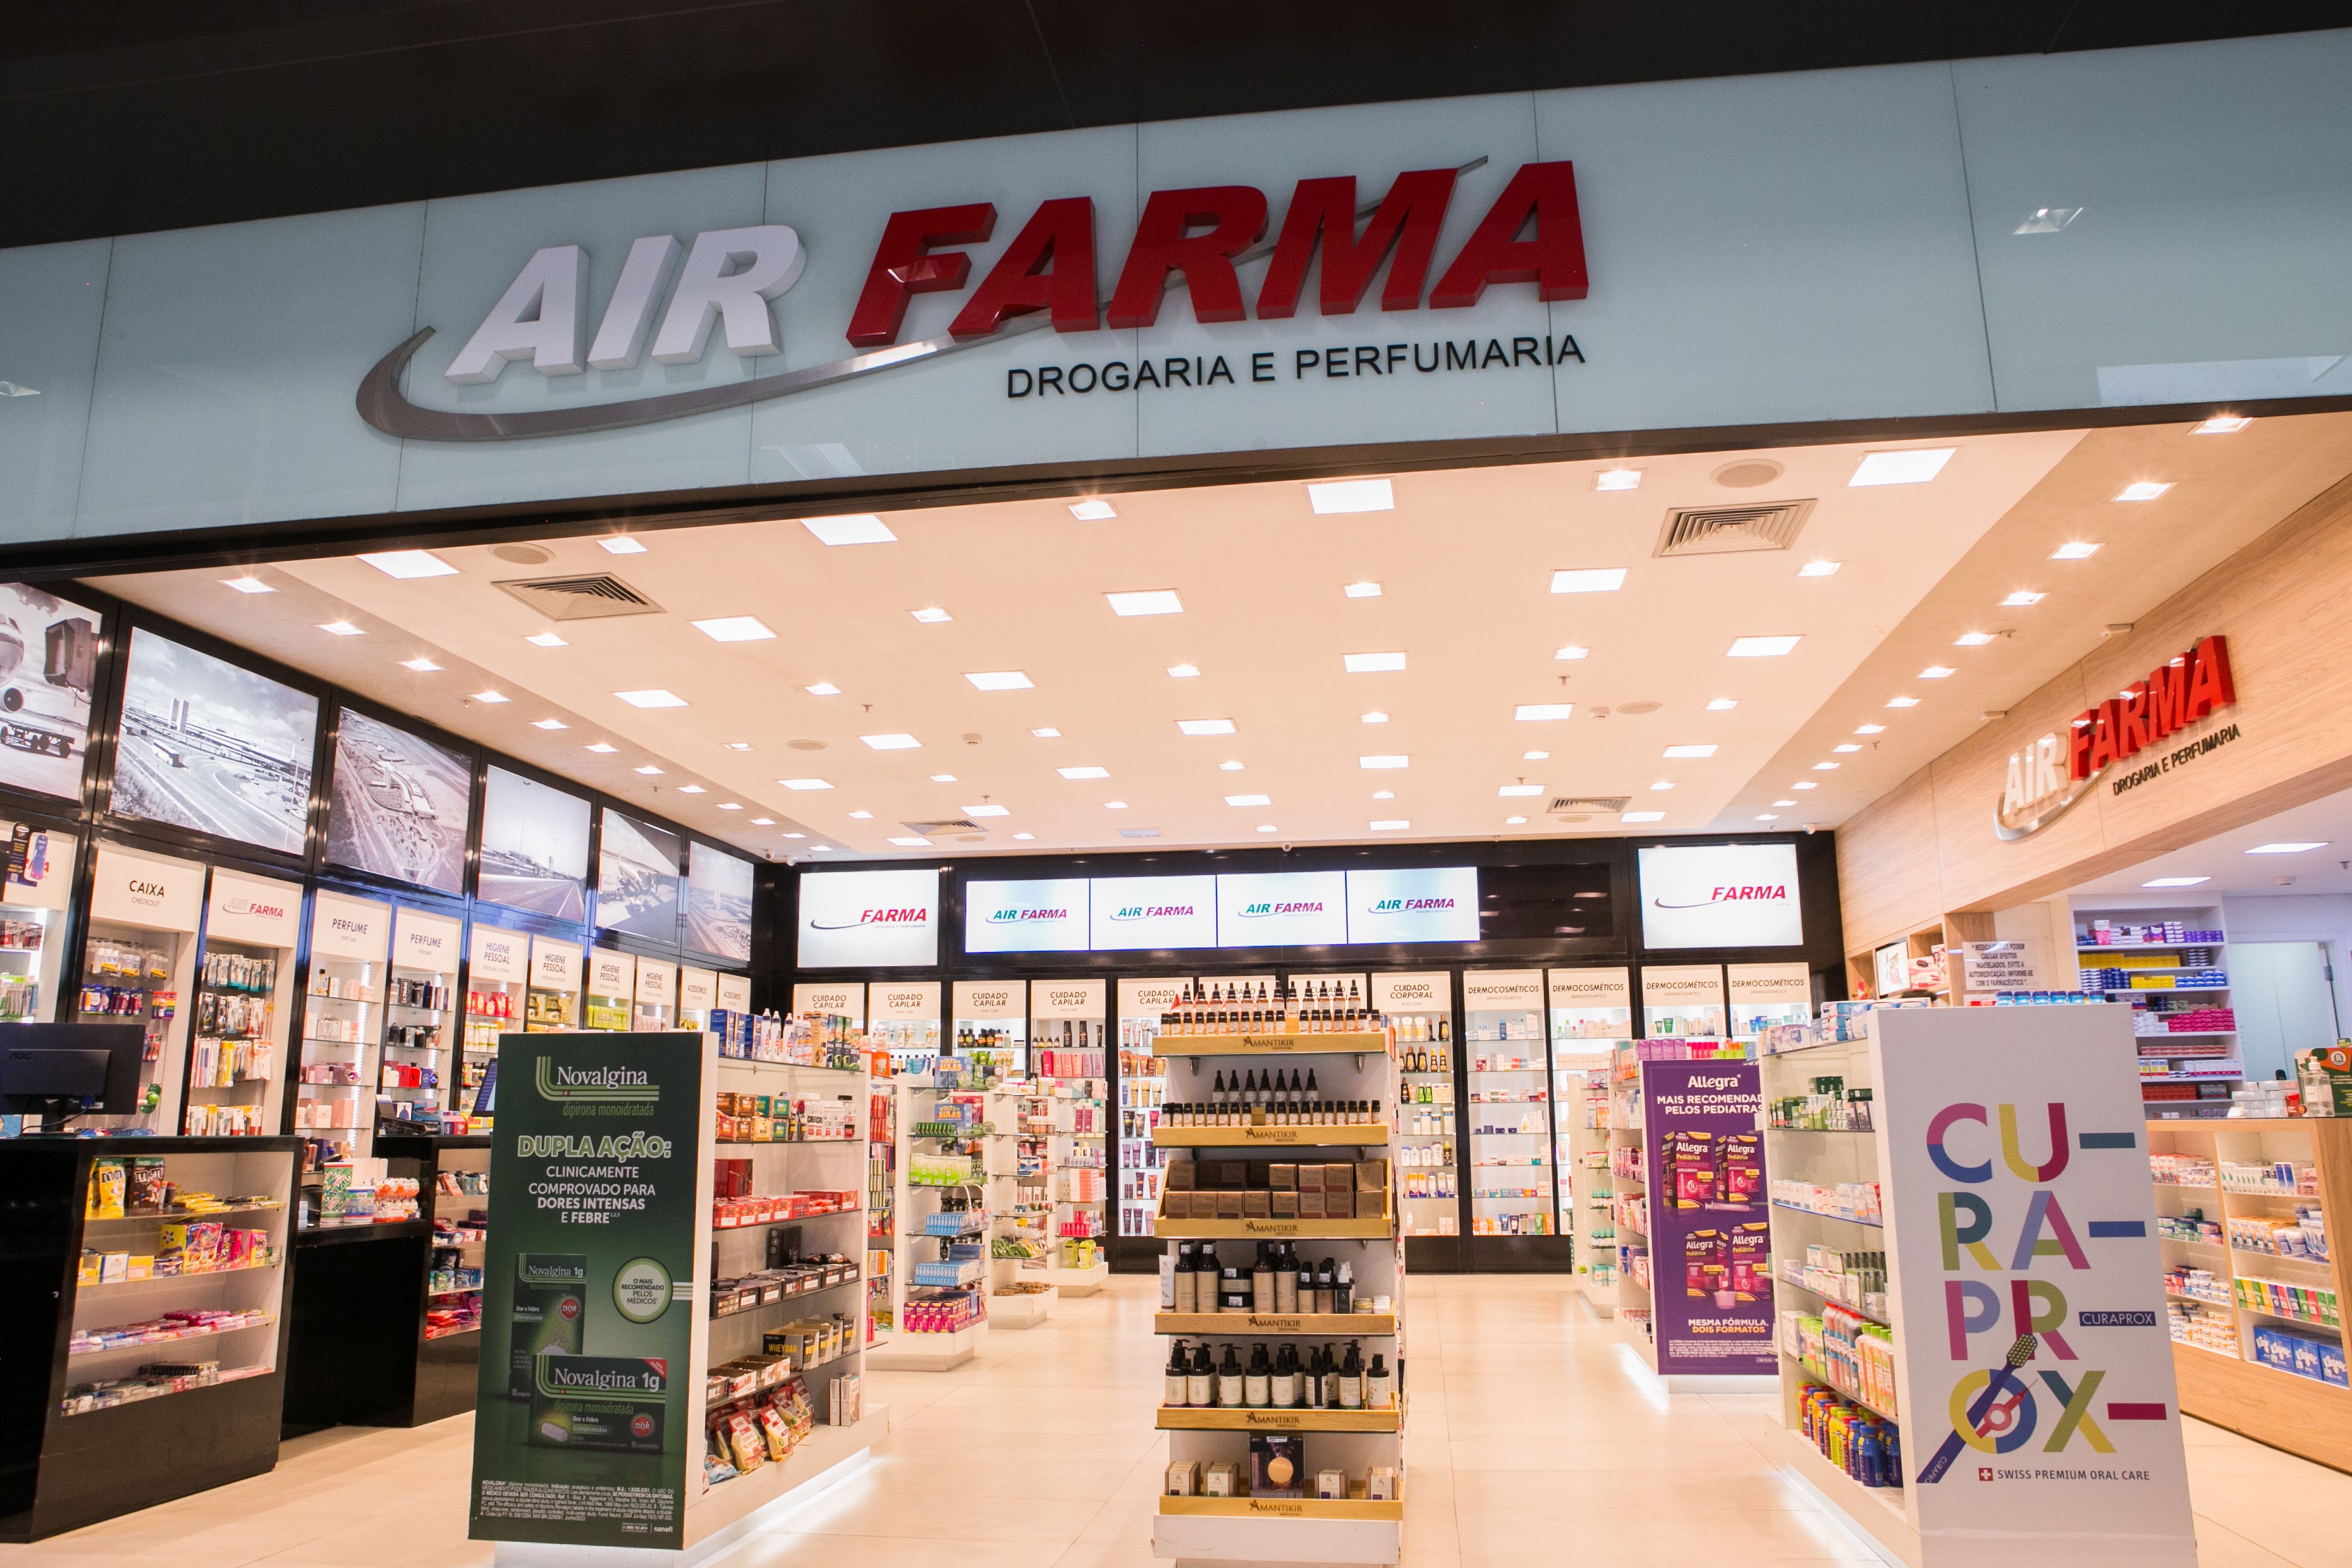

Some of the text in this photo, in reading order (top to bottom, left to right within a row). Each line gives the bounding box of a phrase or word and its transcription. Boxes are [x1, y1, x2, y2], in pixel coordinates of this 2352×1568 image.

[445, 160, 1589, 384] AIR FARMA
[1007, 334, 1586, 399] DROGARIA E PERFUMARIA
[2002, 635, 2236, 816] AIR FARMA
[2112, 723, 2241, 796] DROGARIA E PERFUMARIA
[129, 880, 165, 897] CAIXA
[1712, 885, 1786, 900] FARMA
[131, 897, 160, 907] CHECKOUT
[229, 897, 248, 911] AIR
[249, 903, 283, 918] FARMA
[1245, 902, 1323, 913] AIR FARMA
[1375, 899, 1455, 910] AIR FARMA
[860, 908, 926, 923] FARMA
[993, 909, 1067, 919] AIR FARMA
[1118, 906, 1194, 916] AIR FARMA
[332, 918, 368, 934] PERFUME
[410, 934, 442, 948] PERFUME
[486, 942, 510, 954] HIGIENE
[484, 952, 509, 964] PESSOAL
[544, 953, 566, 964] HIGIENE
[543, 962, 566, 974] PESSOAL
[601, 963, 620, 974] HIGIENE
[599, 972, 620, 983] PESSOAL
[646, 971, 663, 981] HIGIENE
[1732, 977, 1804, 987] DERMOCOSMÉTICOS
[645, 980, 663, 990] PESSOAL
[1468, 984, 1539, 994] DERMOCOSMÉTICOS
[1553, 982, 1624, 992] DERMOCOSMÉTICOS
[1647, 979, 1718, 990] DERMOCOSMÉTICOS
[556, 1066, 648, 1089] Novalgina
[1657, 1094, 1762, 1104] MAIS RECOMENDAD
[563, 1101, 654, 1119] dipirona monoidratada
[938, 1111, 962, 1119] AULAS
[1665, 1104, 1763, 1114] PELOS PEDIATRAS
[518, 1131, 672, 1163] DUPLA AÇÃO:
[1676, 1142, 1708, 1154] Allegra
[1727, 1144, 1755, 1155] Allegra
[546, 1166, 640, 1178] CLINICAMENTE
[528, 1182, 656, 1195] COMPROVADO PARA
[538, 1197, 645, 1210] DORES INTENSAS
[561, 1212, 568, 1222] E
[1686, 1241, 1713, 1250] Allegra
[1732, 1235, 1763, 1246] Allegra
[528, 1265, 583, 1278] Novalgina 1g
[1722, 1317, 1769, 1327] FÓRMULA,
[2081, 1313, 2153, 1326] CURAPROX
[554, 1368, 660, 1393] Novalgina 1g
[554, 1399, 634, 1414] dipirona monoidratada
[1998, 1469, 2150, 1480] SWISS PREMIUM ORAL CARE
